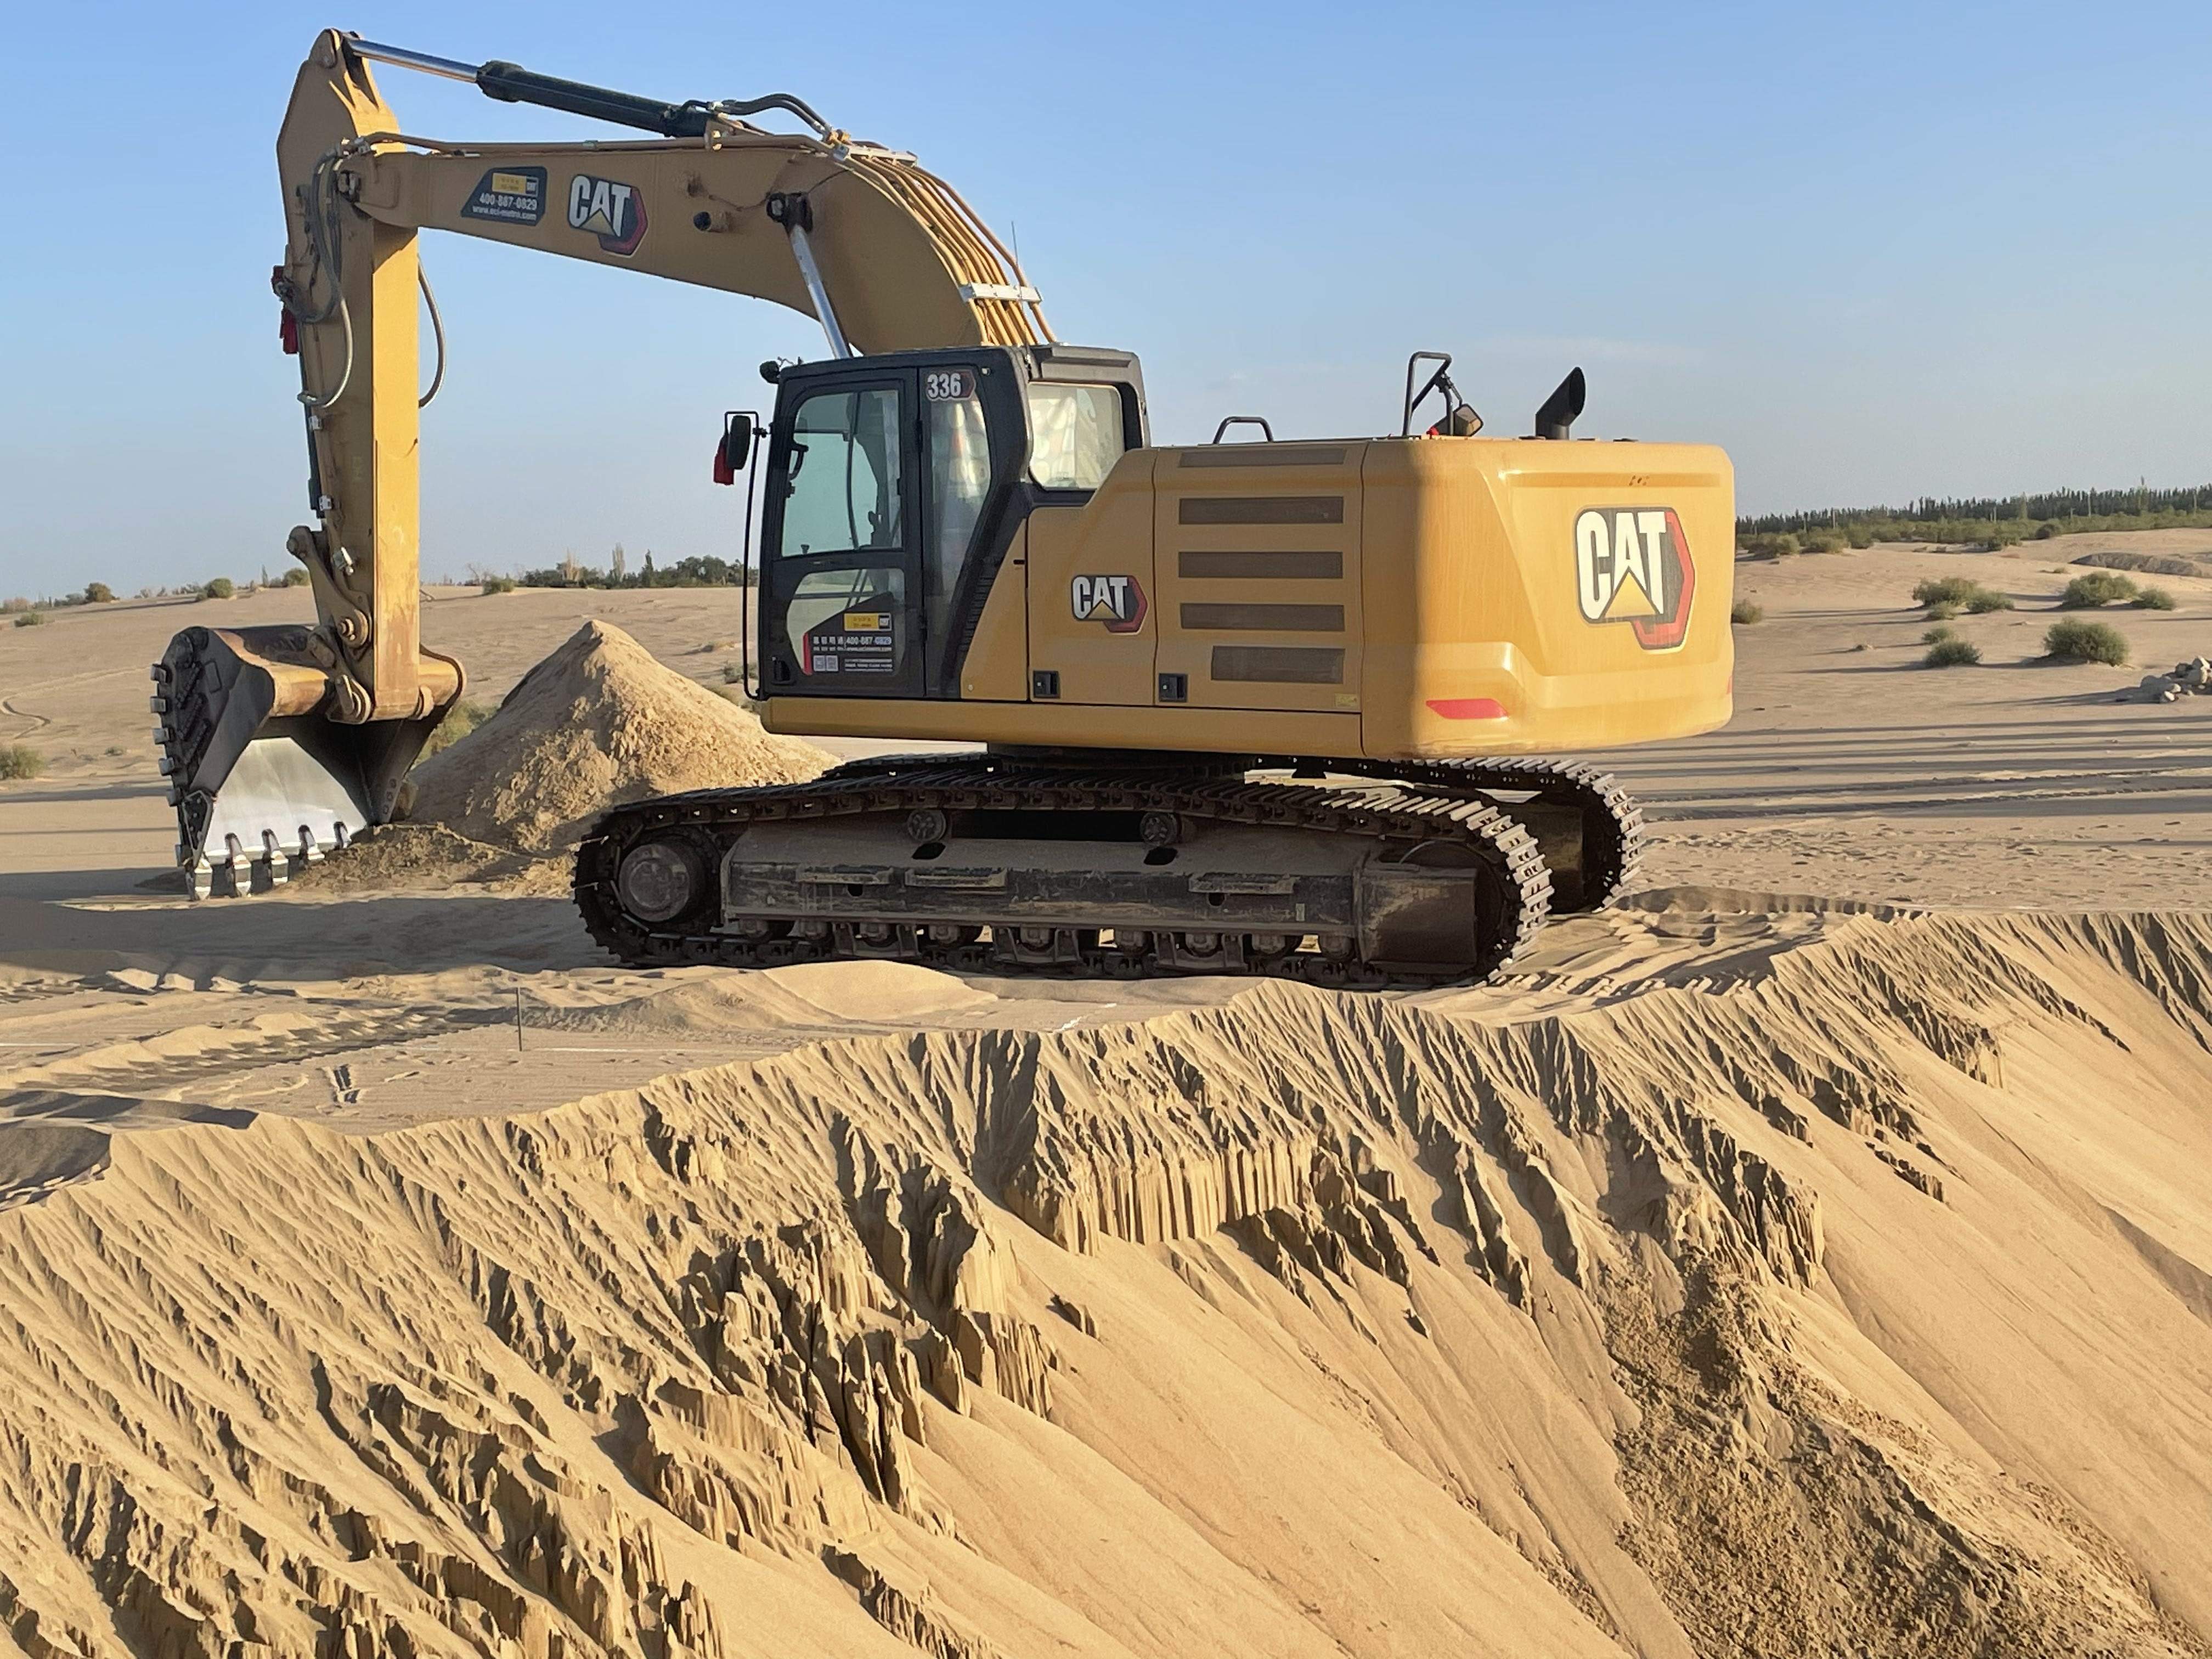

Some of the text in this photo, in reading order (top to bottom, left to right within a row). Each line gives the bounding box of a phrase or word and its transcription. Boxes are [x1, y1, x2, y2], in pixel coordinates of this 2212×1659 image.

[569, 175, 631, 237] CAT
[927, 373, 961, 398] 336
[1576, 511, 1667, 619] CAT
[1073, 576, 1128, 619] CAT
